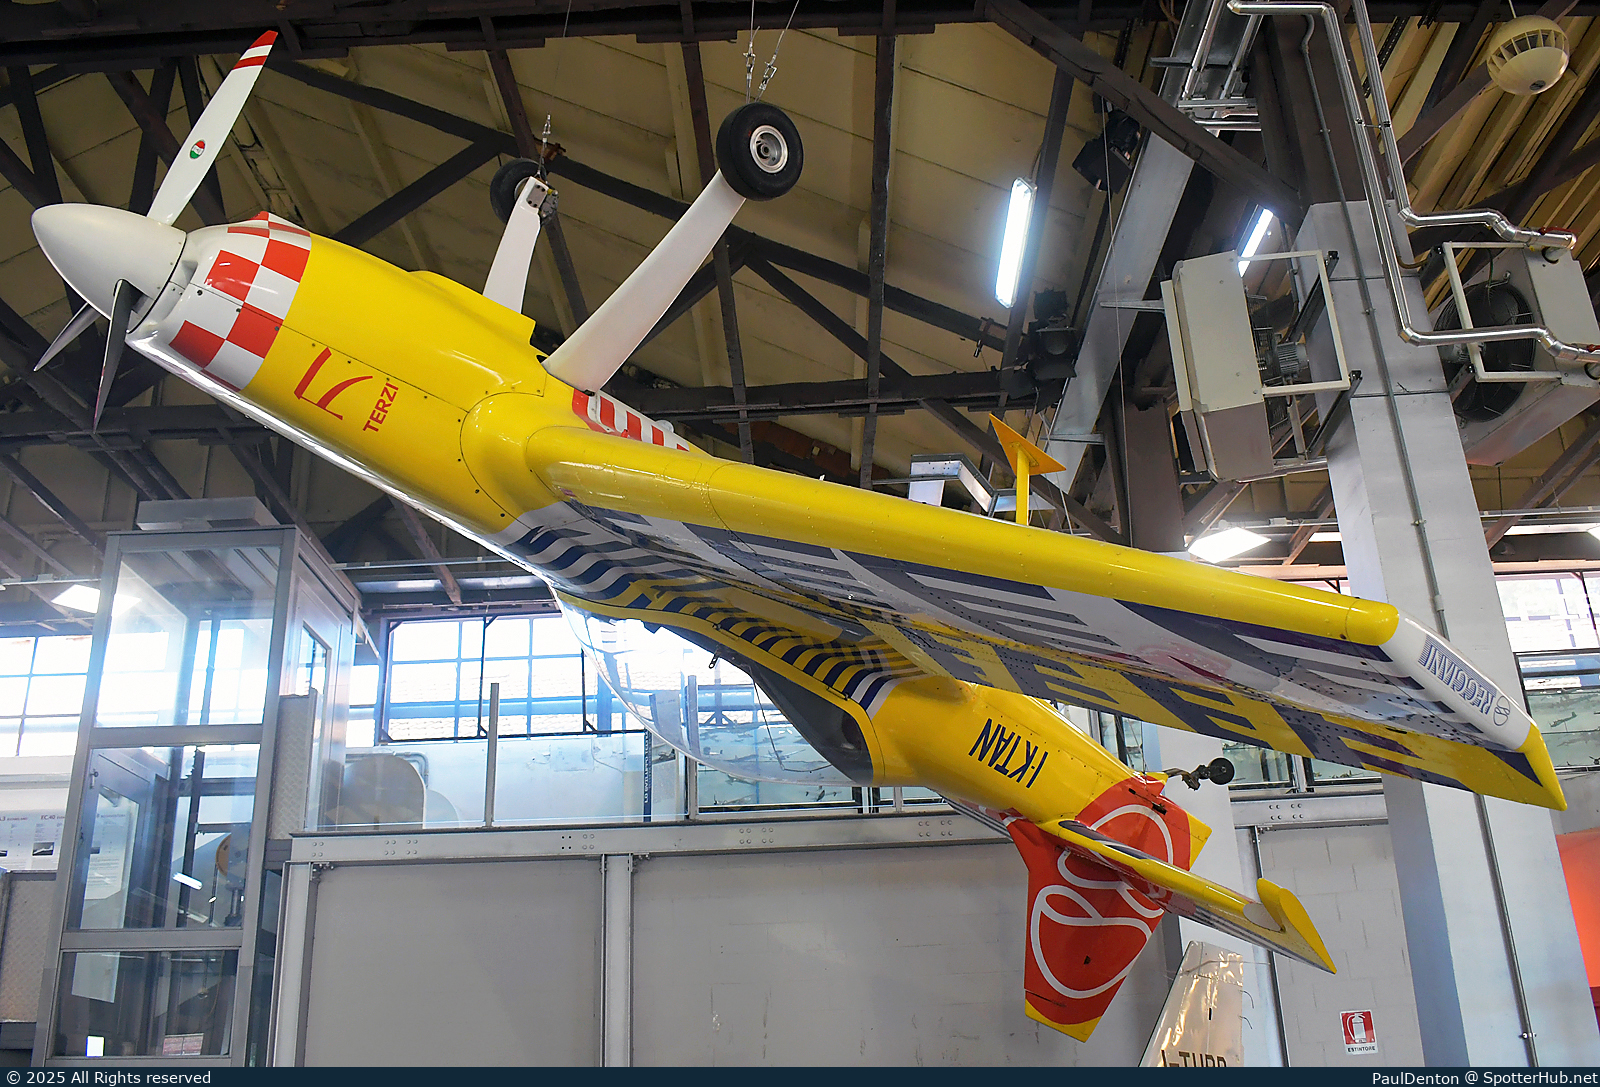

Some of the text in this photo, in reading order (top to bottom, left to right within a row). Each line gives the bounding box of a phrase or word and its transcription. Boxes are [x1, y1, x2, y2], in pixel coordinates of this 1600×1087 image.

[362, 382, 399, 432] TERZI
[1421, 643, 1495, 715] REGGIANI
[1347, 1045, 1376, 1053] ESTINTORE
